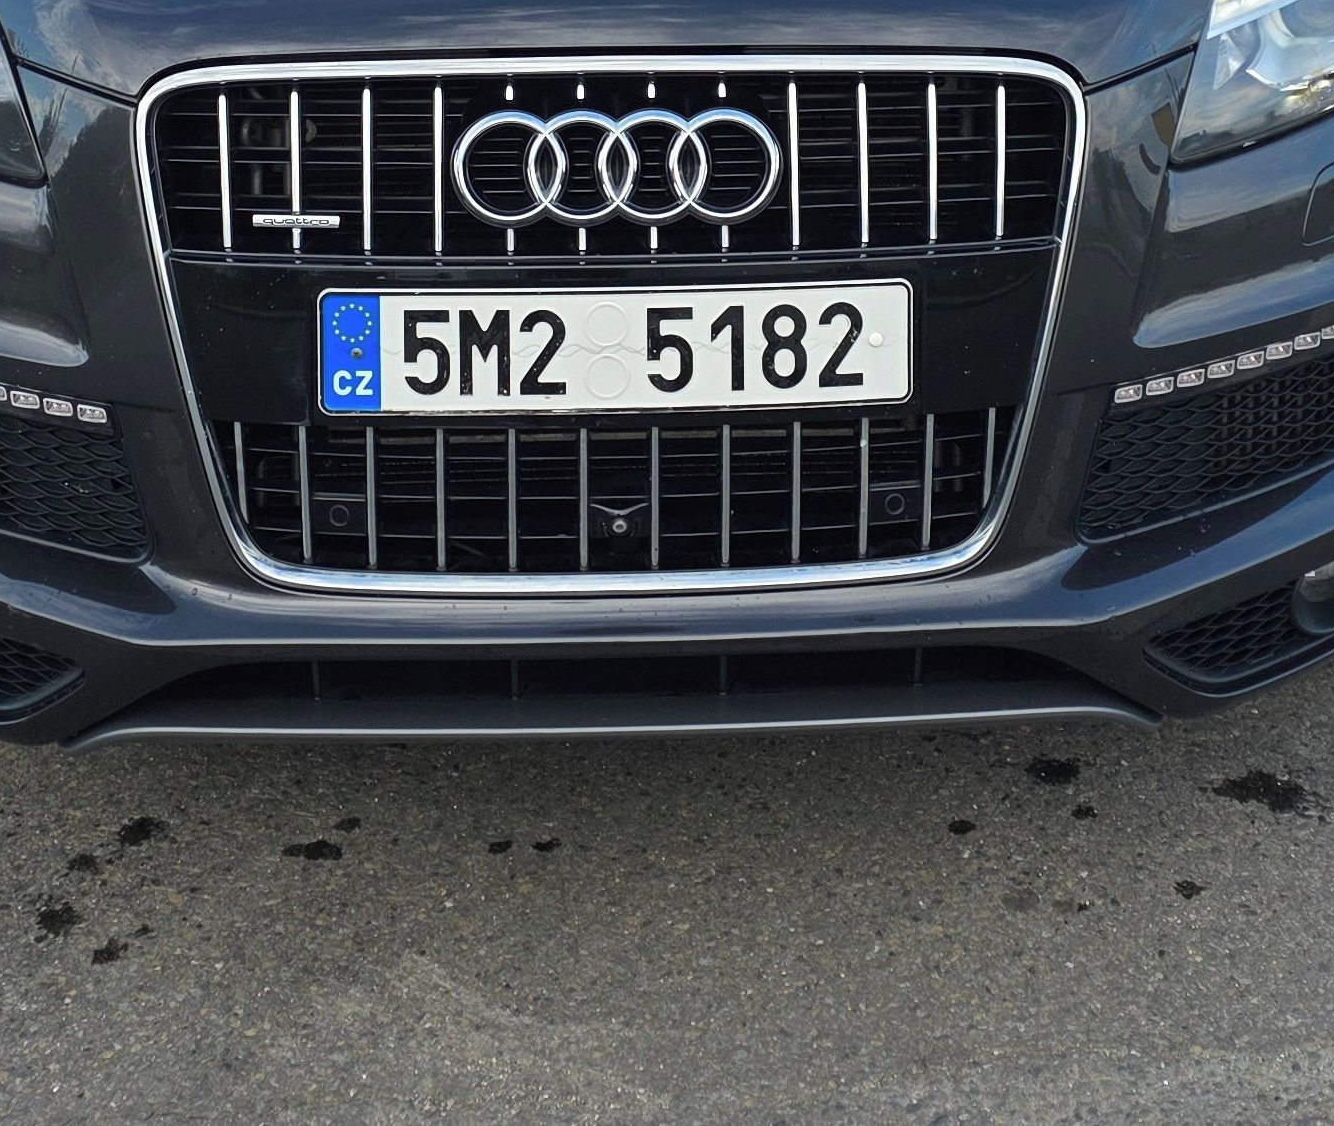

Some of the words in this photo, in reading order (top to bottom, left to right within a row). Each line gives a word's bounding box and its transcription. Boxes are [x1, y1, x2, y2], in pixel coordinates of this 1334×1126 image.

[263, 217, 330, 225] quattro
[403, 309, 567, 397] 5M2
[645, 301, 864, 393] 5182
[333, 370, 373, 396] CZ
